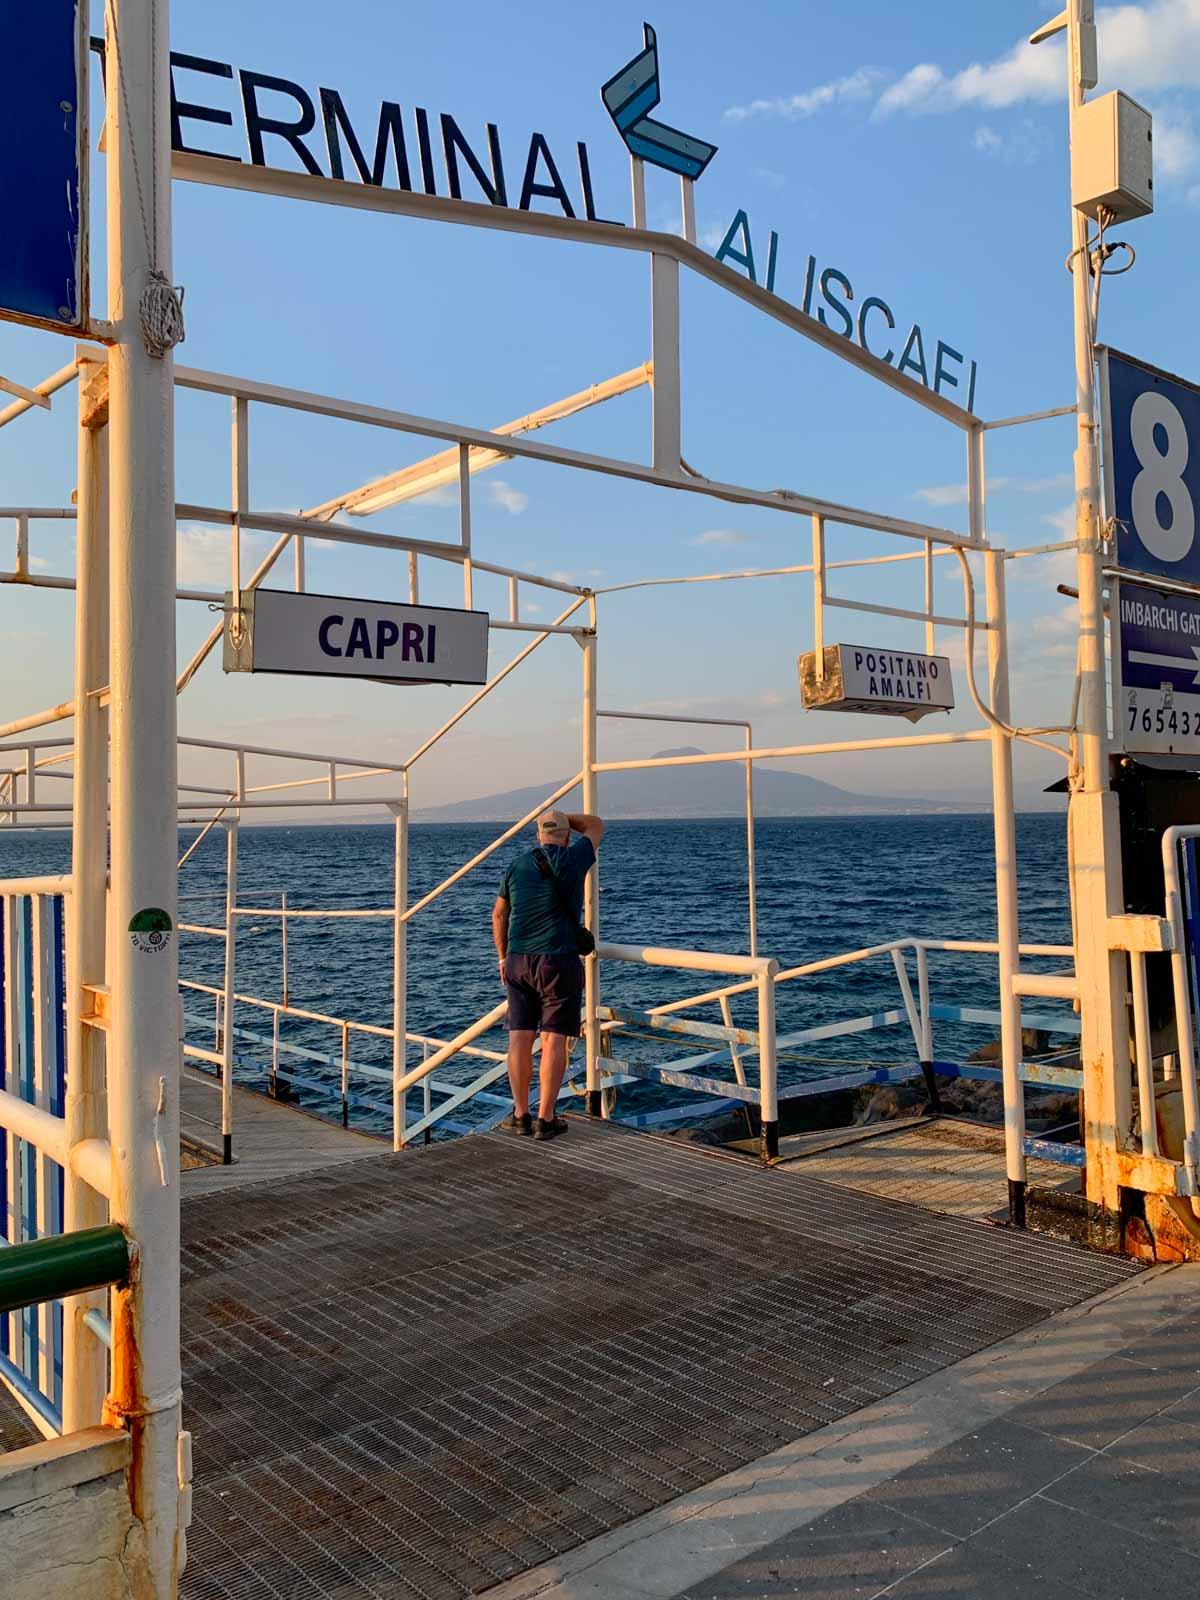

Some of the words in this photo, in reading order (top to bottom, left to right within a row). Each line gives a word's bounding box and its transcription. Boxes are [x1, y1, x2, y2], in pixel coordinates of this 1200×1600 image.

[1130, 391, 1195, 562] 8
[1120, 599, 1179, 633] IMBARCHI
[318, 614, 437, 664] CAPRI
[854, 651, 939, 680] POSITANO
[869, 676, 932, 701] AMALFI
